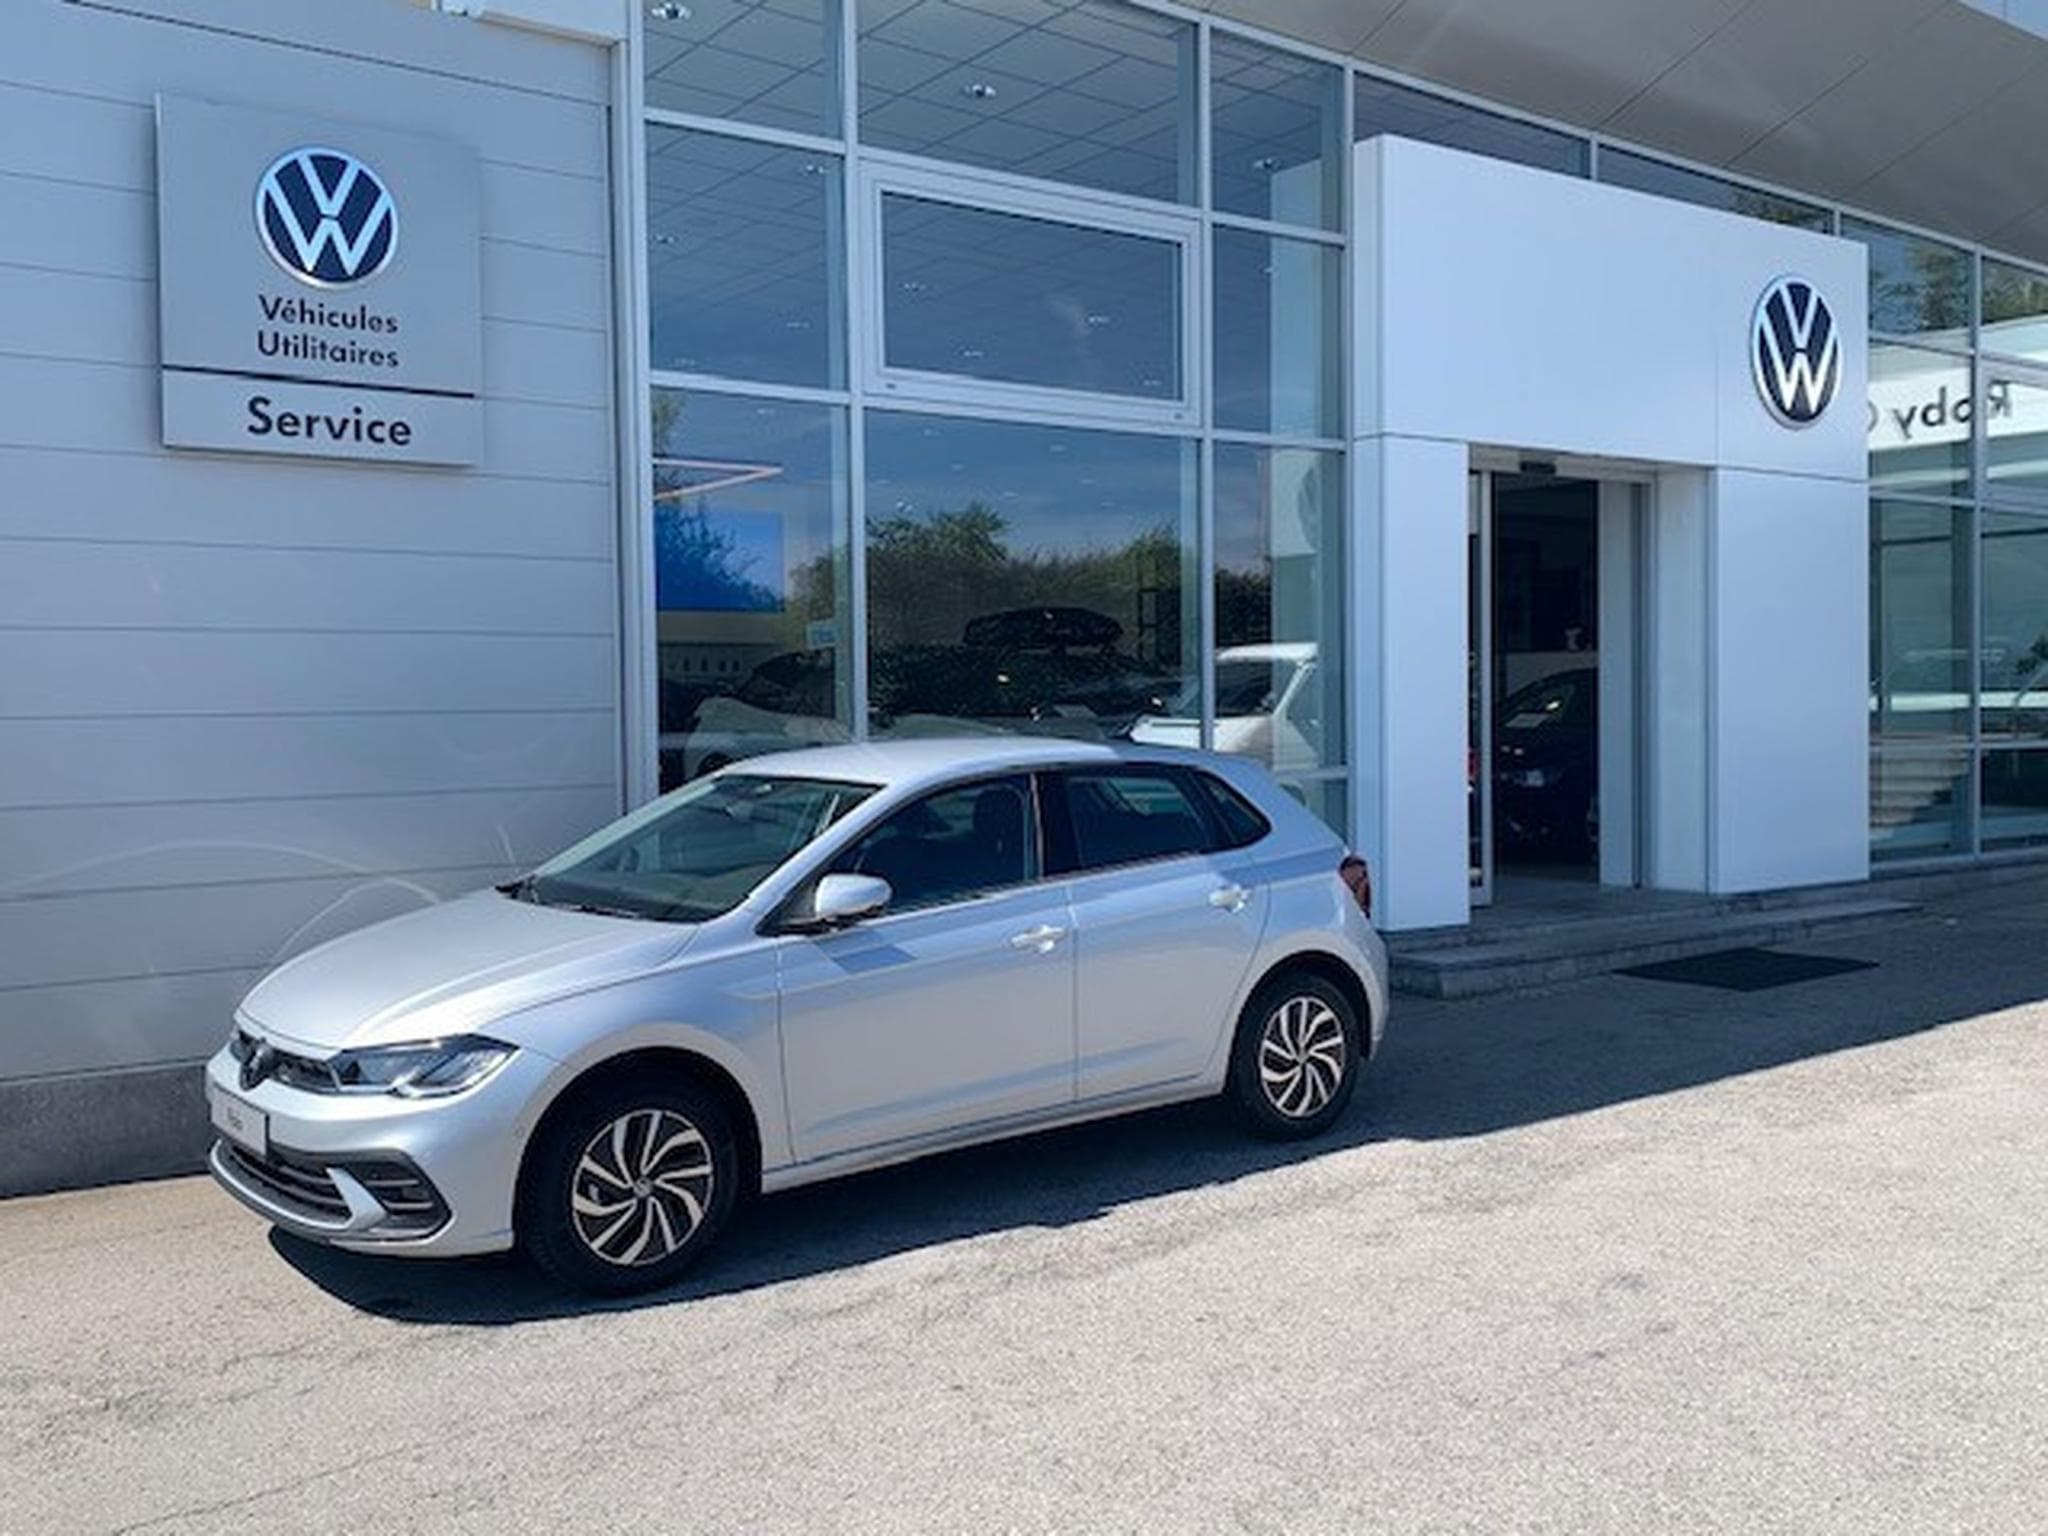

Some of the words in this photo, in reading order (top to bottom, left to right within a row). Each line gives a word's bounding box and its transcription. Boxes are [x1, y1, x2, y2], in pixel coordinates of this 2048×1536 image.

[258, 294, 398, 333] Véhicules
[258, 330, 399, 367] Utilitaires
[247, 396, 412, 446] Service
